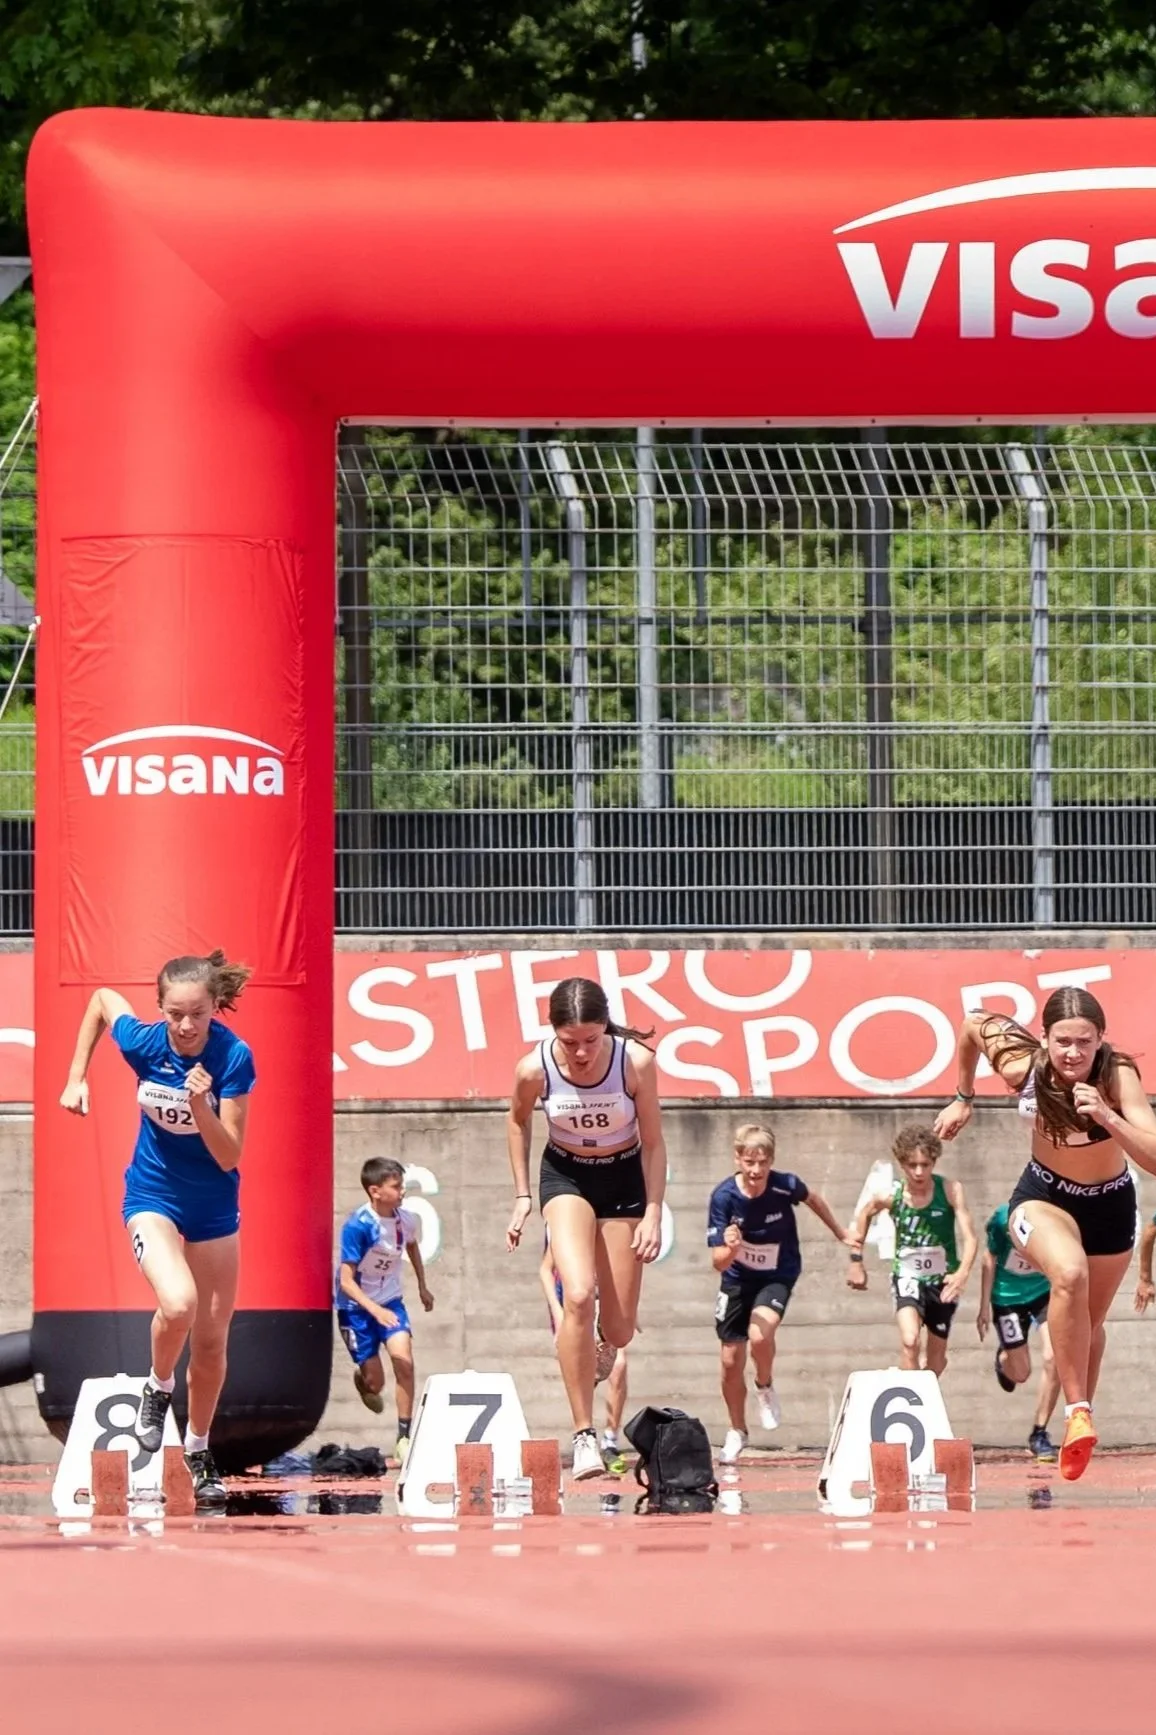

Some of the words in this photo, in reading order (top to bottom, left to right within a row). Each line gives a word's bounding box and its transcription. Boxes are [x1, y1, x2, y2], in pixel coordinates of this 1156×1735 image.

[332, 950, 812, 1073] STERO
[155, 1106, 193, 1126] 192
[569, 1113, 610, 1128] 168
[1056, 1180, 1102, 1197] NIKE
[1102, 1170, 1131, 1195] PRO
[374, 1259, 393, 1271] 25
[744, 1251, 767, 1265] 110
[914, 1258, 933, 1270] 30
[1003, 1318, 1017, 1338] 3
[448, 1393, 503, 1443] 7
[870, 1386, 926, 1463] 6
[93, 1393, 153, 1473] 8
